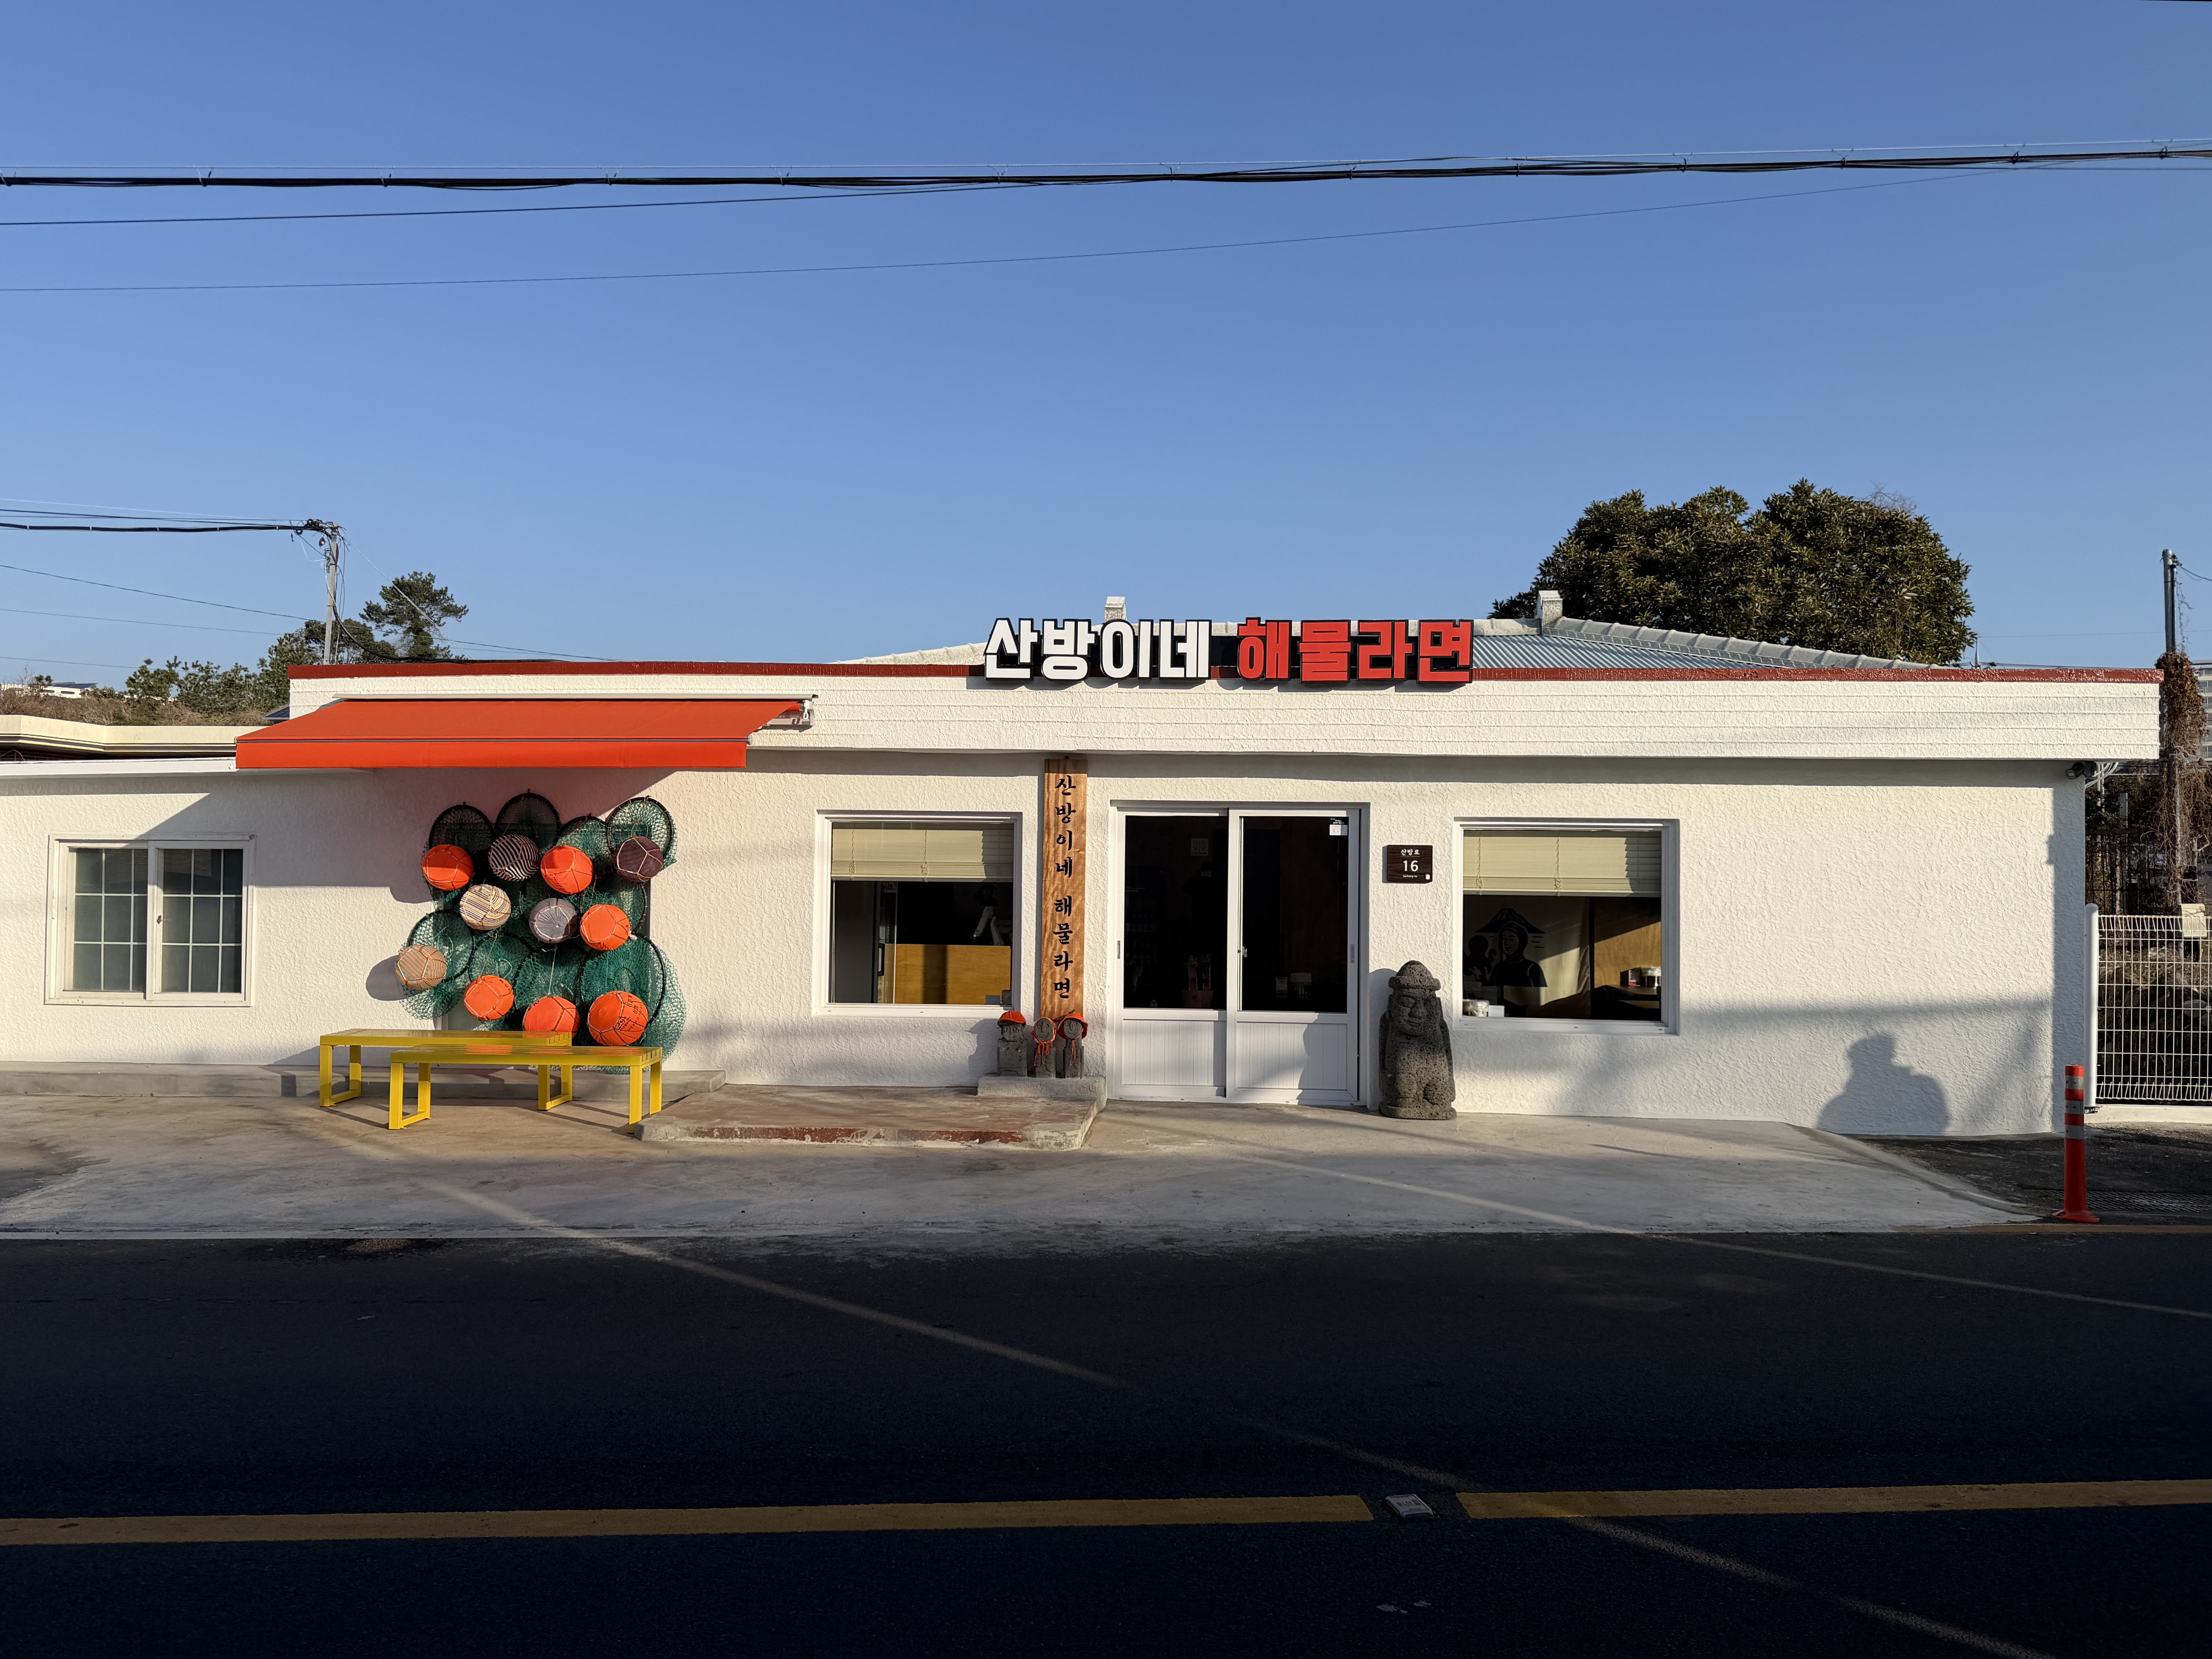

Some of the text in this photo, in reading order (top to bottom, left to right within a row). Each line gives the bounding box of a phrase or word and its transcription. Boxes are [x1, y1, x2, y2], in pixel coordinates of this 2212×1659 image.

[984, 617, 1474, 683] 산방이네 해물라면
[1053, 775, 1076, 999] 산방이네 해물라면
[1403, 860, 1418, 872] 16
